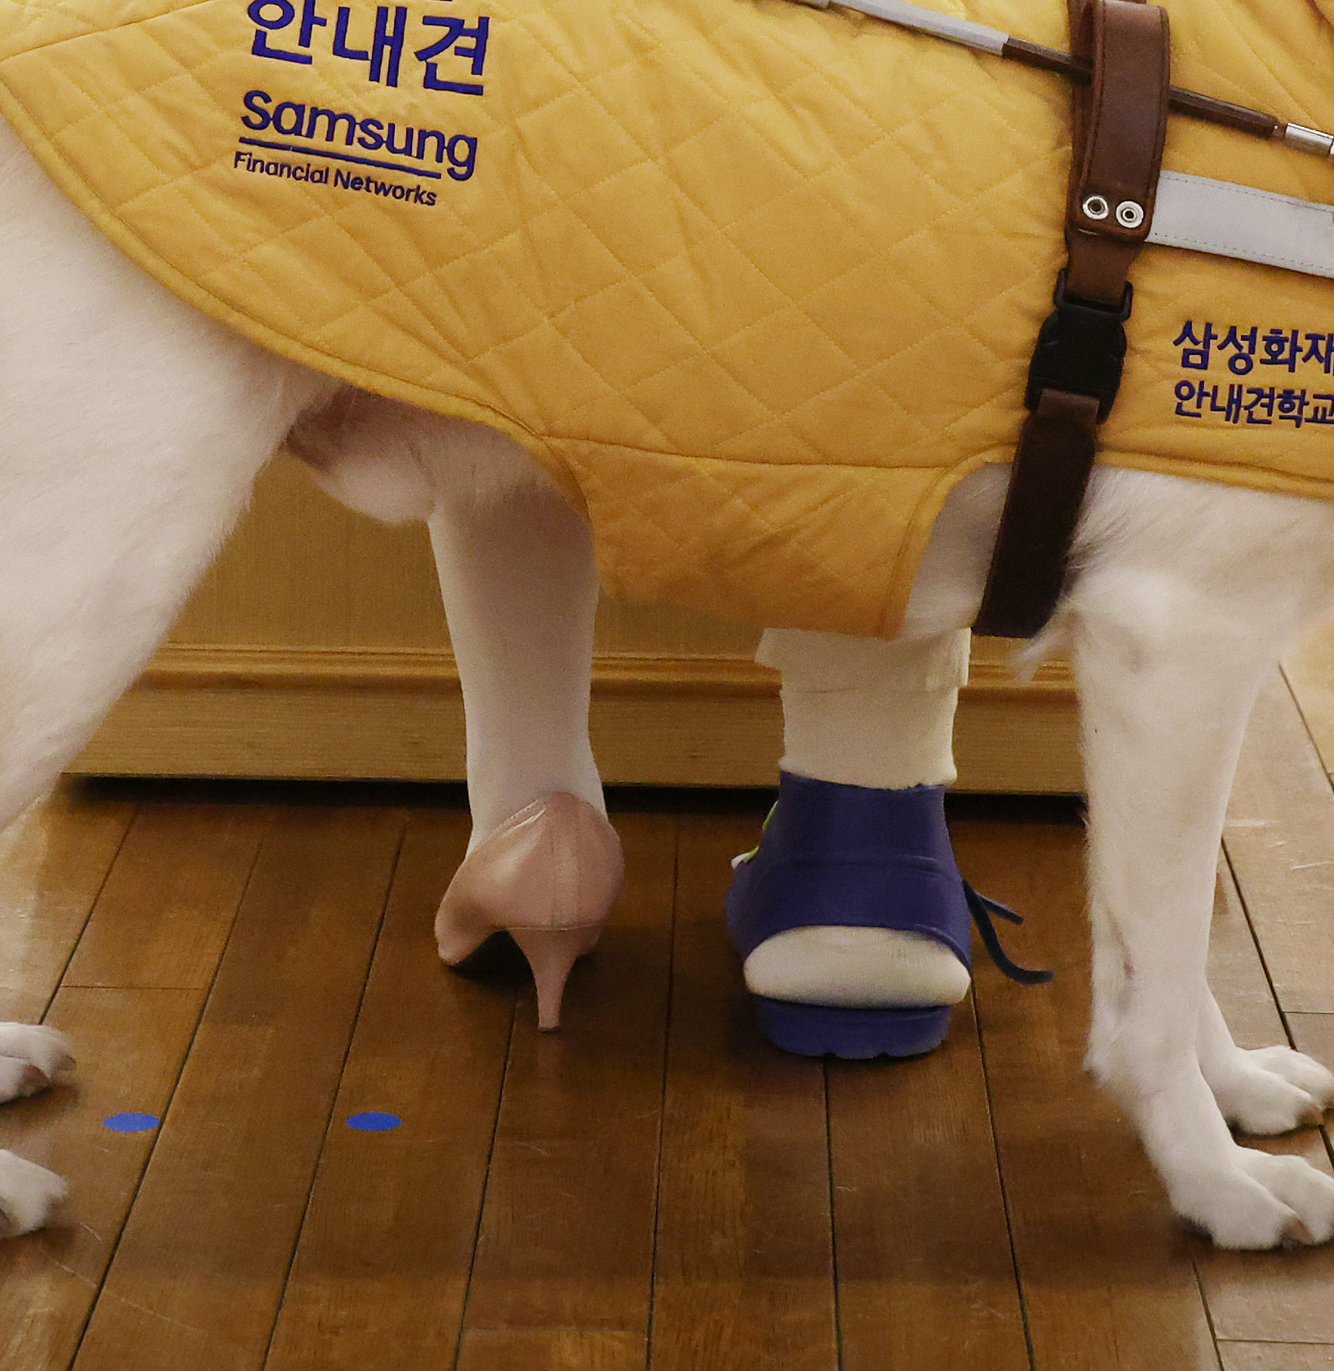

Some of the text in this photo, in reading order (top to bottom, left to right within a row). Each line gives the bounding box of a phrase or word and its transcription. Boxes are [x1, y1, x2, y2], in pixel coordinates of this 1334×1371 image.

[240, 90, 478, 181] Samsung
[233, 151, 437, 206] Financial Networks
